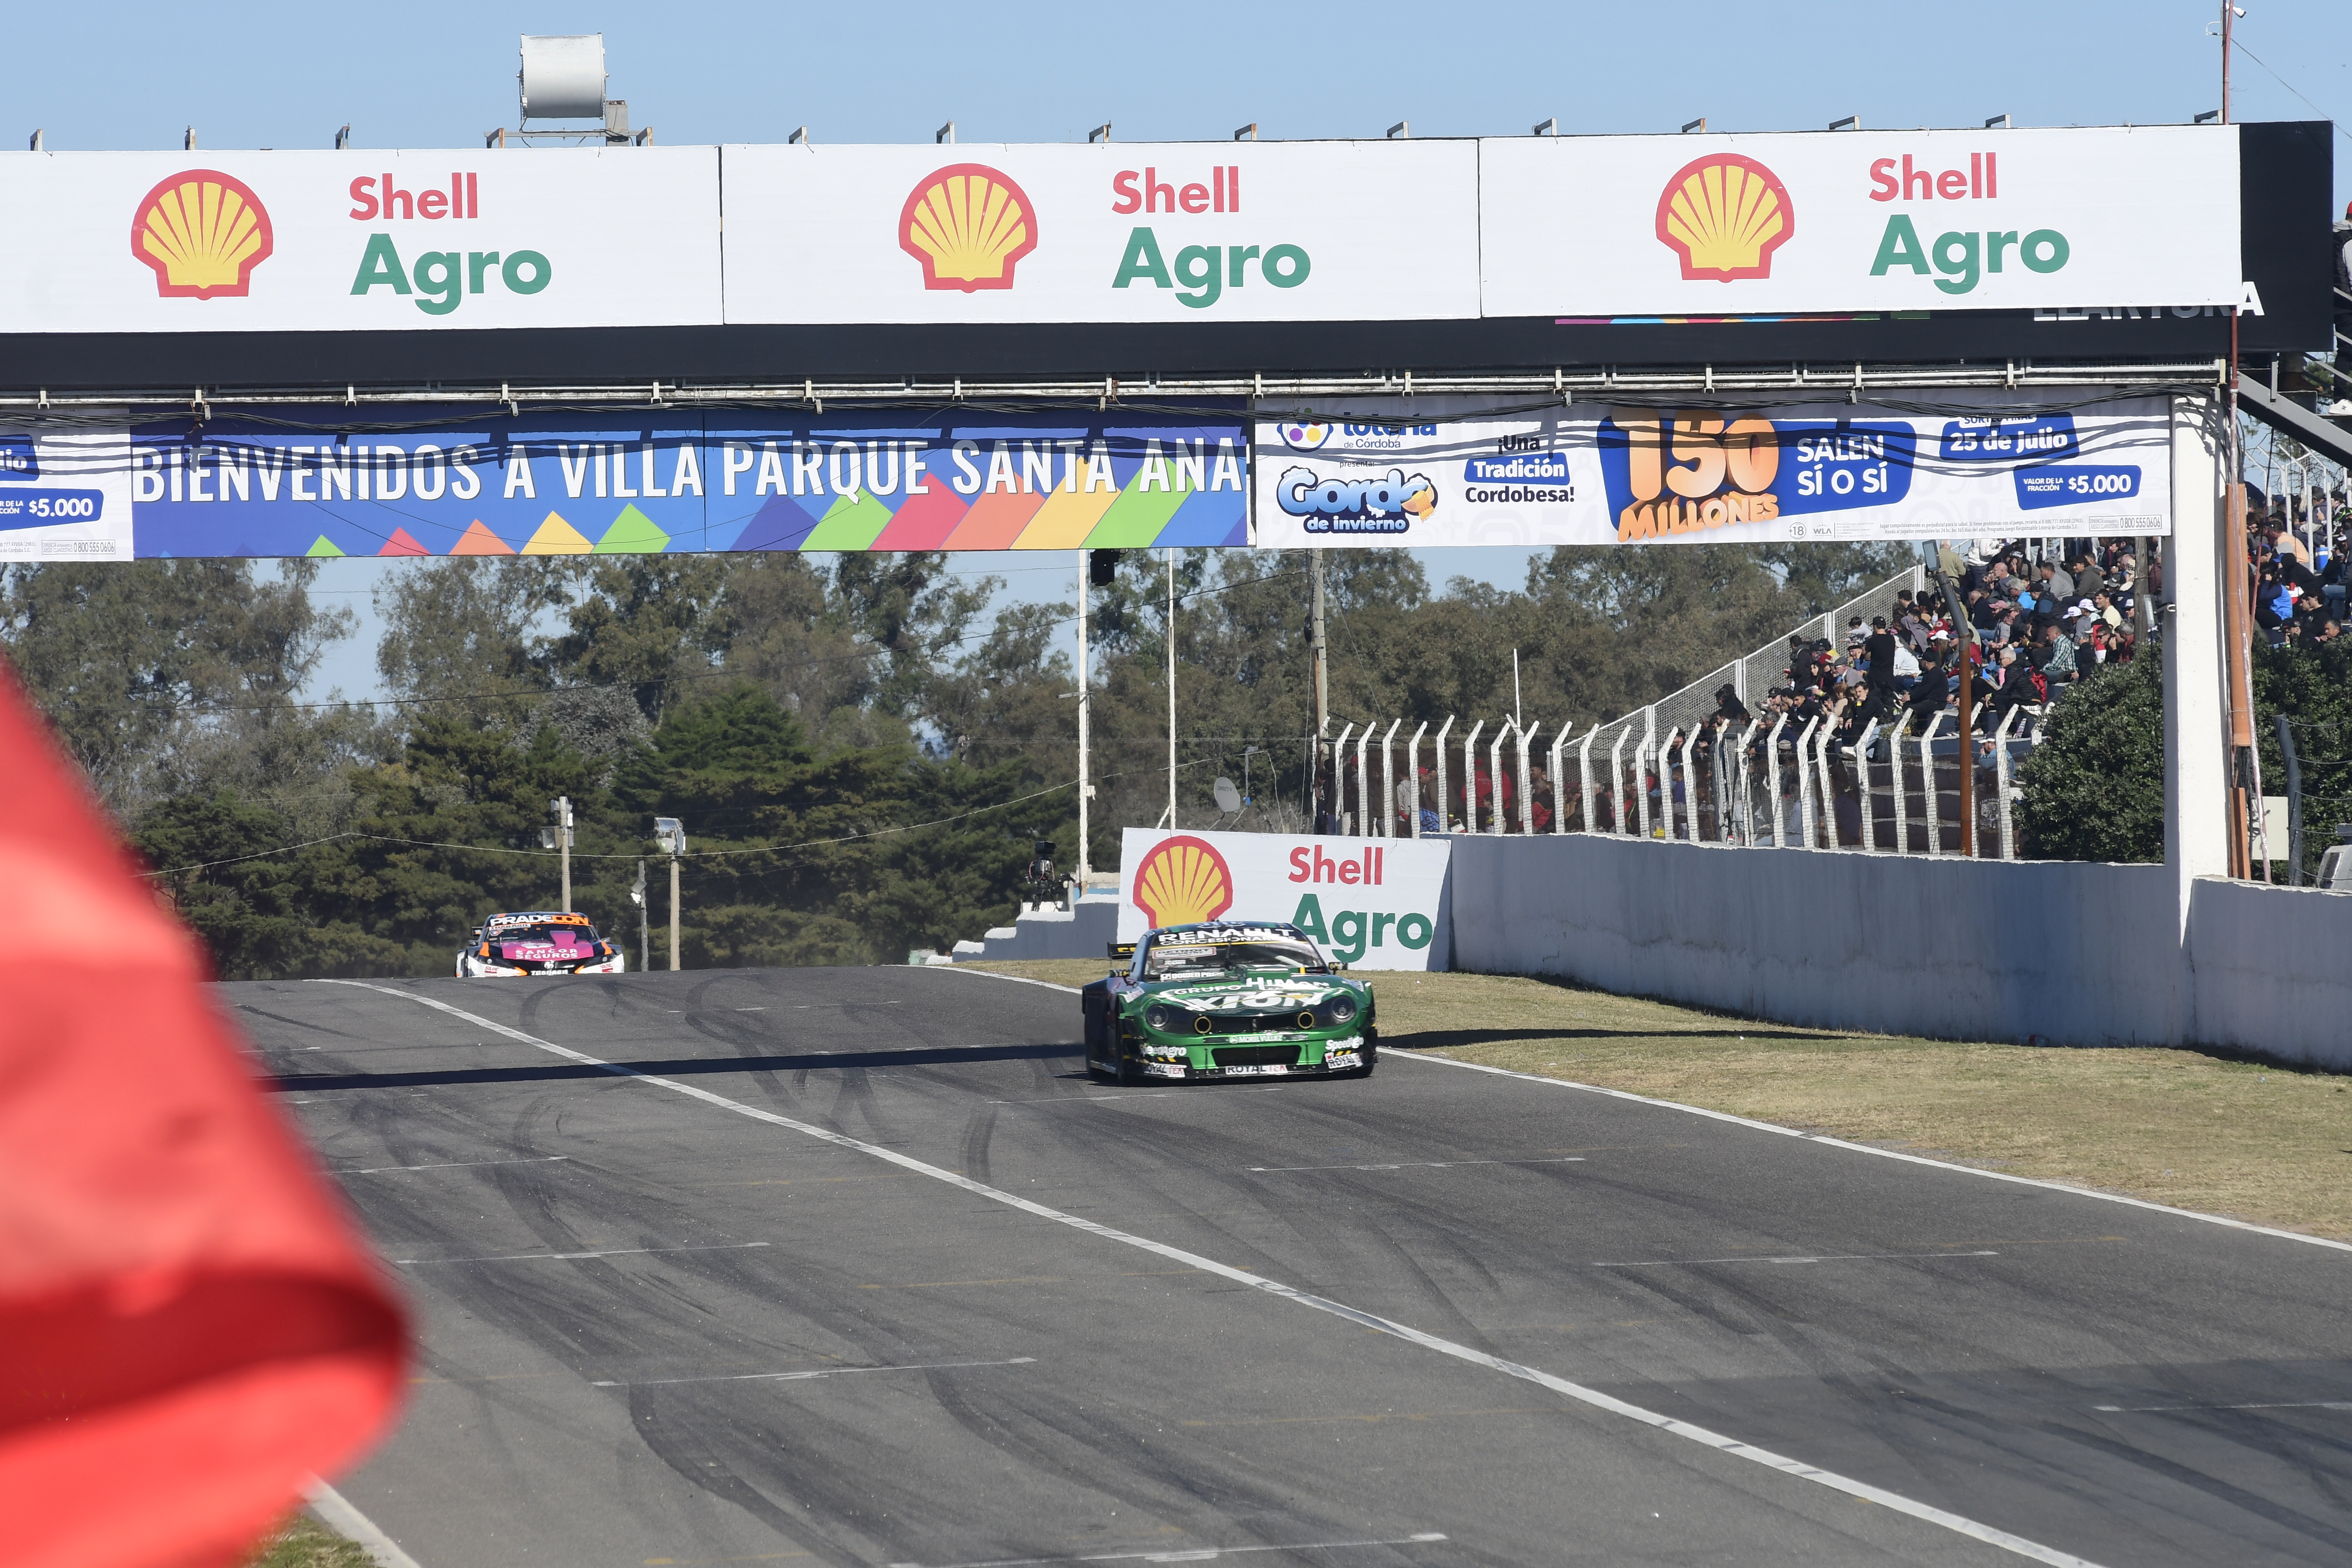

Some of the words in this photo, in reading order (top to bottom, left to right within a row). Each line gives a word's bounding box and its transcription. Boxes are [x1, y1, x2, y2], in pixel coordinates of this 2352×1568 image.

[1111, 166, 1239, 214] Shell
[1870, 152, 1997, 202] Shell
[349, 172, 477, 220] Shell
[1111, 227, 1311, 308] Agro
[1870, 214, 2070, 295] Agro
[350, 233, 552, 316] Agro
[1356, 438, 1401, 448] Córdoba
[1497, 435, 1541, 455] ¡Una
[1797, 436, 1884, 462] SALEN
[1950, 432, 1978, 451] 25
[1983, 430, 2012, 450] de
[2016, 426, 2068, 454] Julio
[1611, 408, 1779, 501] 150
[132, 444, 481, 502] BIENVENIDOS
[504, 444, 536, 499] A
[558, 442, 705, 498] VILLA
[724, 440, 929, 505] PARQUE
[952, 439, 1118, 495] SANTA
[1139, 437, 1243, 492] ANA
[1473, 458, 1565, 479] Tradición
[1798, 464, 1822, 495] SÍ
[1832, 470, 1855, 494] O
[1863, 462, 1887, 493] SÍ
[1277, 466, 1438, 516] Gordo
[1465, 486, 1575, 503] Cordobesa!
[2069, 474, 2132, 493] $5.000
[29, 498, 93, 517] $5.000
[1617, 494, 1779, 542] MILLONES
[1307, 516, 1330, 531] de
[1333, 515, 1406, 530] invierno
[1788, 525, 1804, 536] +18
[2136, 517, 2146, 528] 555
[89, 542, 99, 552] 555
[1288, 844, 1383, 885] Shell
[490, 915, 589, 926] PRADECON
[1292, 893, 1433, 963] Agro
[1158, 928, 1294, 942] RENAULT
[1160, 936, 1296, 945] CONCESIONARS
[1174, 984, 1242, 994] GRUPO
